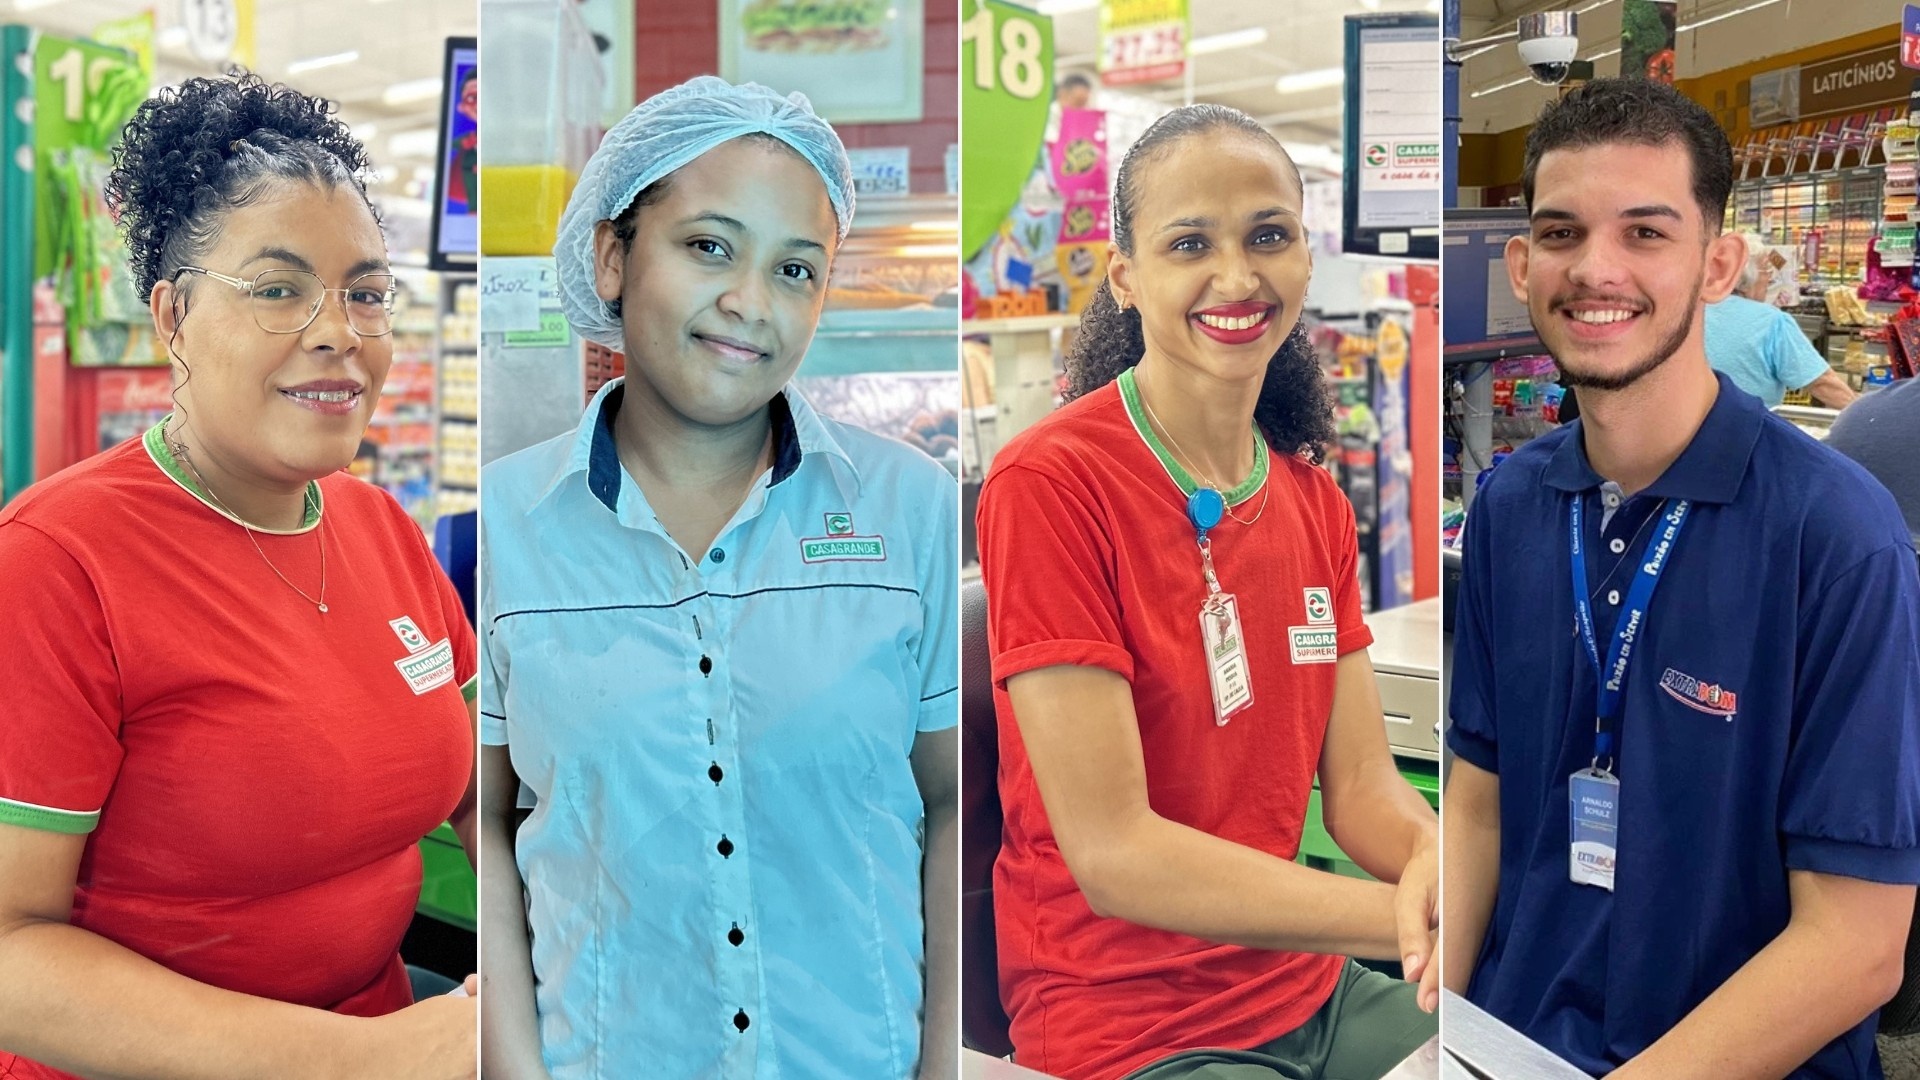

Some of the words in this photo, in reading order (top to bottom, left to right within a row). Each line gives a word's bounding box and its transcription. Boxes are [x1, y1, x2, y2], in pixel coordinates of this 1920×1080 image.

[962, 6, 1044, 98] 18
[1813, 59, 1896, 94] LATICÍNIOS
[811, 543, 878, 556] CASAGRANDE
[405, 647, 452, 677] CASAGRANDE
[1582, 796, 1613, 809] ARNALDO
